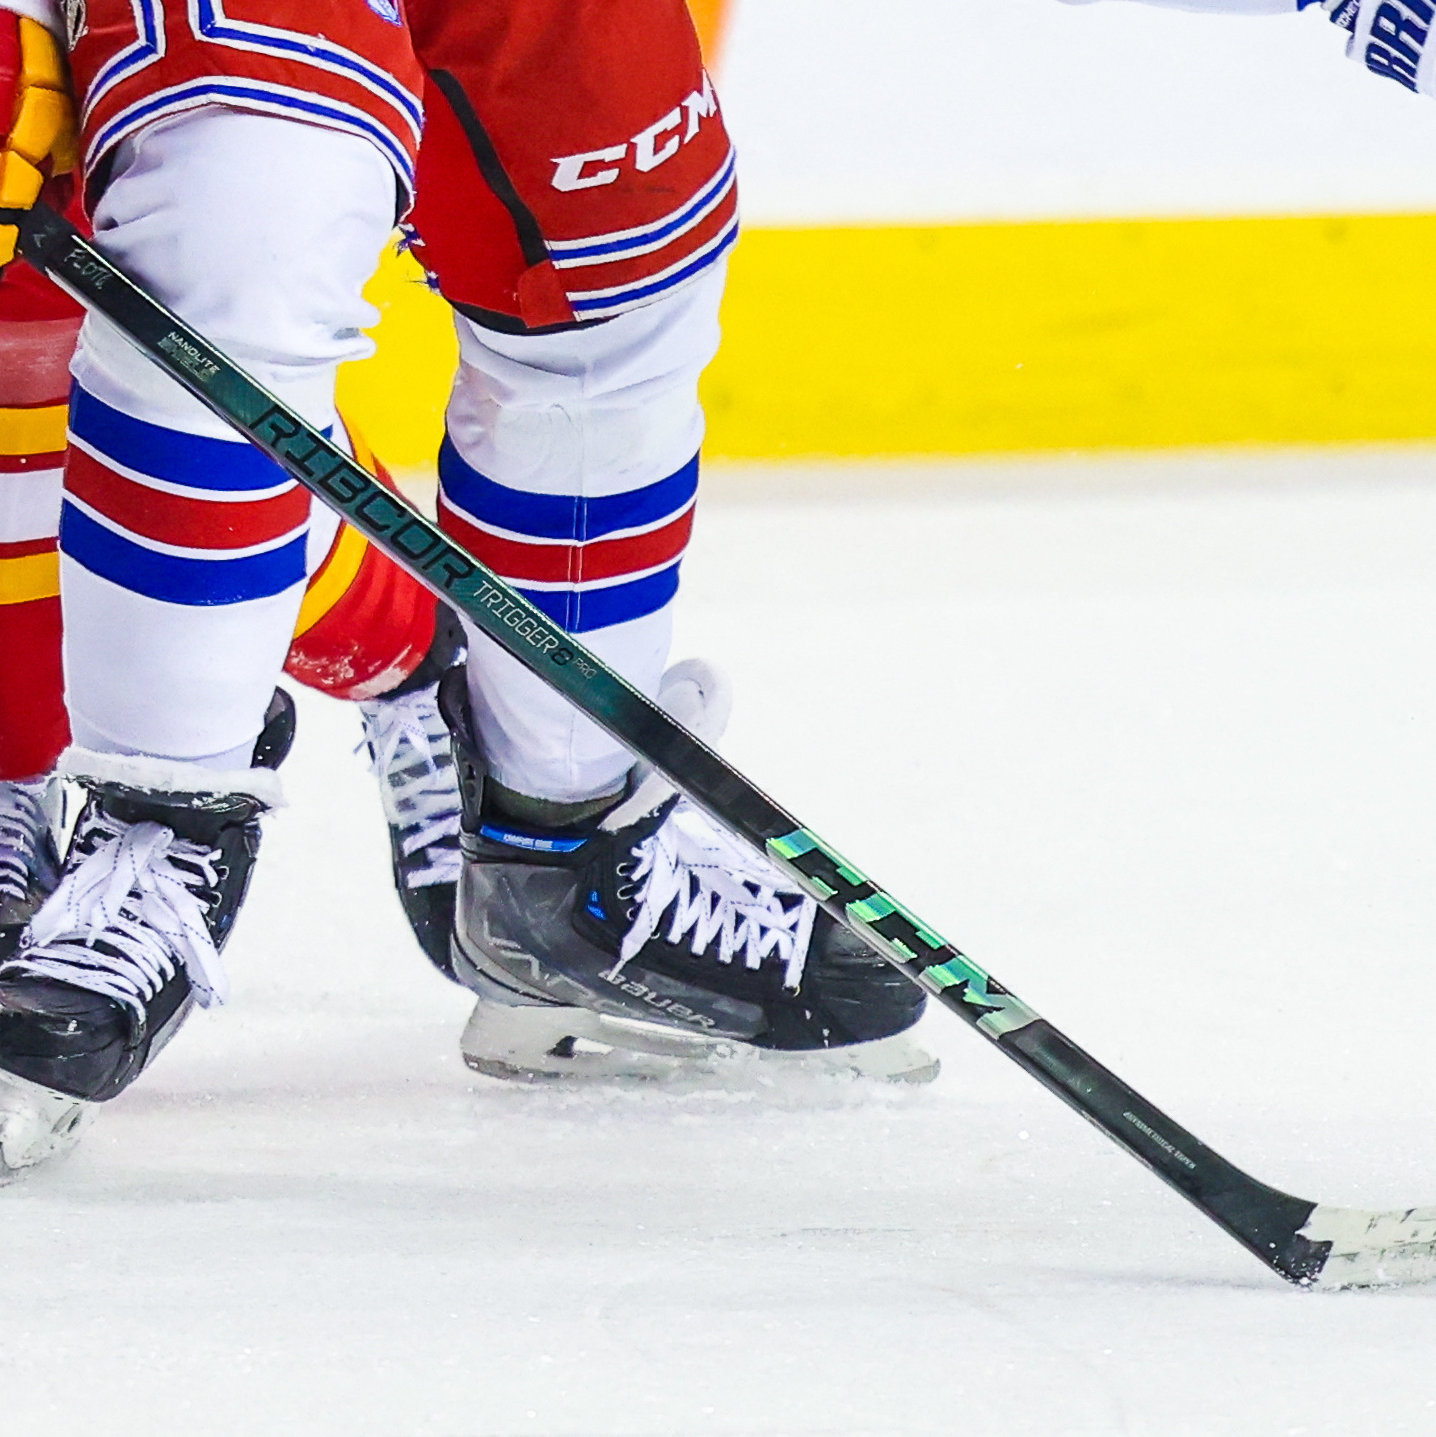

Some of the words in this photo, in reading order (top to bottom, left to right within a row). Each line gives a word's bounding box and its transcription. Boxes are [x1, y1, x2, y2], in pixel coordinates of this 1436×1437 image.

[550, 68, 718, 192] CCM
[167, 331, 221, 373] NANOLITE
[249, 404, 478, 589] RIBCOR
[473, 580, 559, 654] TRIGGER
[573, 658, 597, 679] PRO
[766, 826, 1042, 1040] CCM
